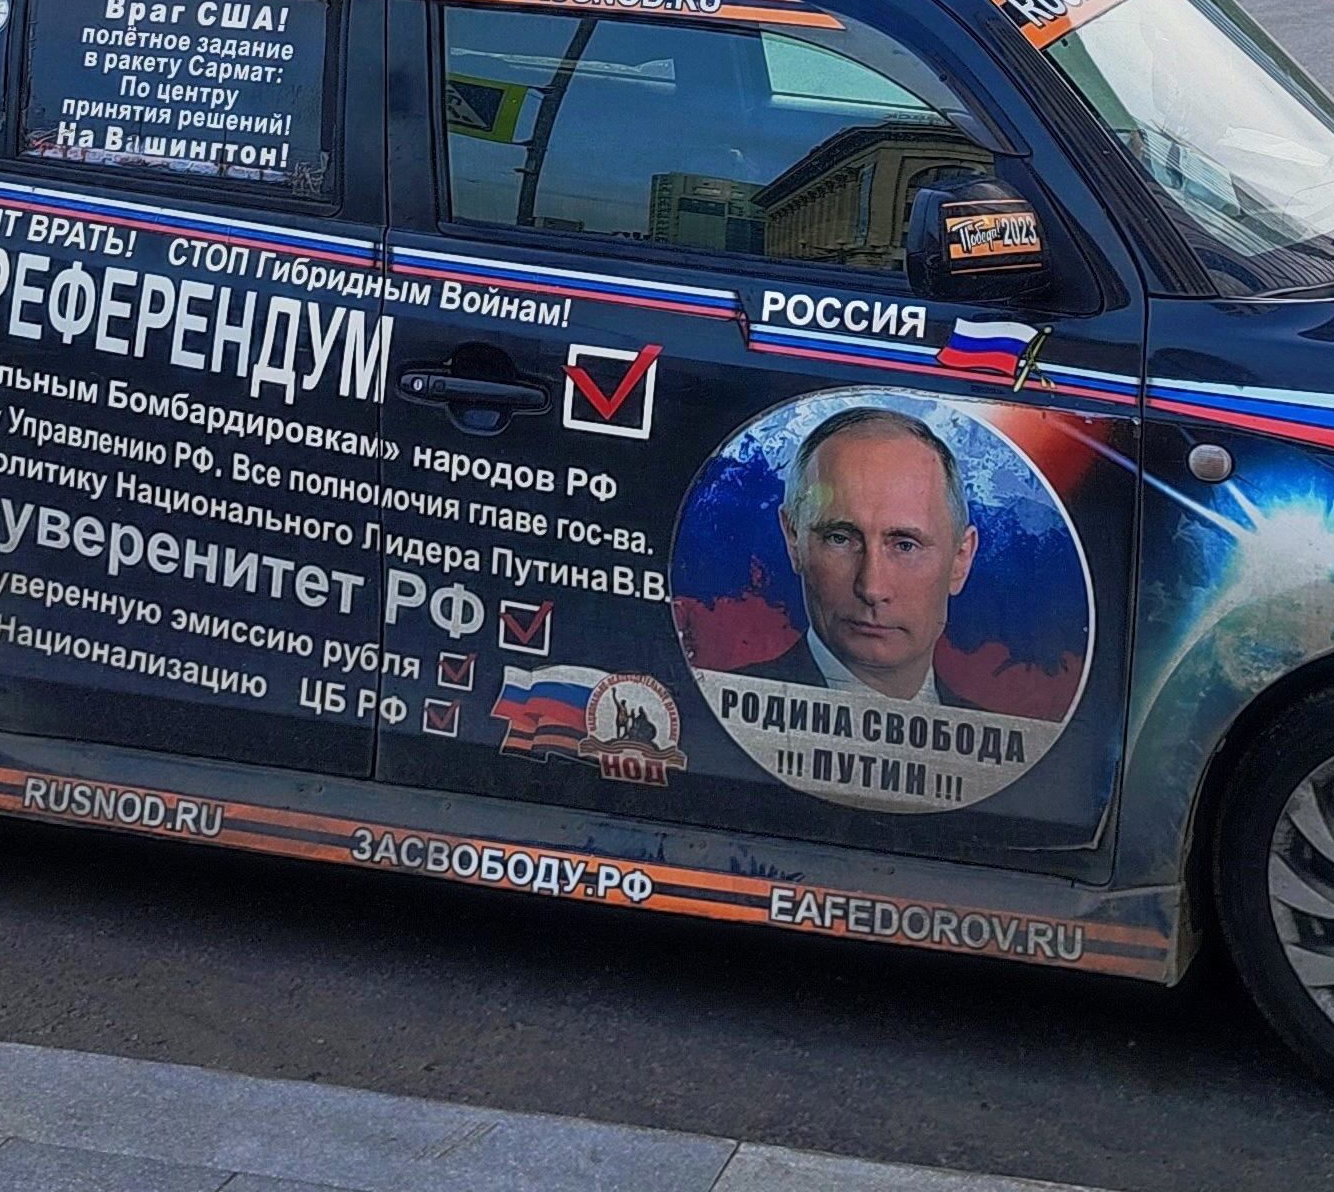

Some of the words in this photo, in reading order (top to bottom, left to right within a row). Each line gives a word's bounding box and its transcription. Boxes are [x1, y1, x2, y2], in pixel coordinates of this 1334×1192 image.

[197, 0, 289, 32] США!
[81, 26, 191, 51] полётное
[196, 37, 294, 61] задание
[83, 51, 98, 67] в
[103, 52, 182, 79] ракету
[188, 55, 284, 84] Сармат:
[62, 98, 172, 125] принятия
[177, 108, 292, 137] решений!
[120, 75, 150, 98] По
[156, 83, 239, 111] центру
[56, 121, 95, 149] На
[104, 125, 289, 168] Вашингтон!
[1002, 217, 1038, 246] 2023
[27, 214, 138, 258] ВРАТЬ!
[168, 237, 249, 277] СТОП
[256, 251, 433, 306] Гибридным
[439, 280, 572, 329] Войнам!
[761, 290, 927, 338] РОССИЯ
[107, 379, 401, 462] Бомбардировкам»
[412, 444, 555, 492] народов
[566, 467, 618, 503] РФ
[8, 407, 167, 465] Управлению
[174, 440, 224, 479] РФ.
[231, 452, 281, 488] Все
[288, 469, 460, 521] полномочия
[467, 500, 548, 537] главе
[557, 517, 655, 555] гос-ва.
[115, 471, 353, 547] Национального
[361, 526, 481, 573] Лидера
[385, 568, 486, 640] РФ
[170, 607, 314, 657] эмиссию
[323, 636, 420, 681] рубля
[299, 677, 346, 716] ЦБ
[356, 688, 408, 726] РФ
[721, 688, 853, 740] РОДИНА
[862, 712, 1025, 765] СВОБОДА
[601, 754, 667, 786] НОД
[812, 748, 926, 797] ПУТИН
[23, 777, 223, 838] RUSNOD.RU
[350, 828, 654, 904] ЗАСВОБОДУ.РФ
[770, 887, 1084, 961] EAFEDOROV.RU
